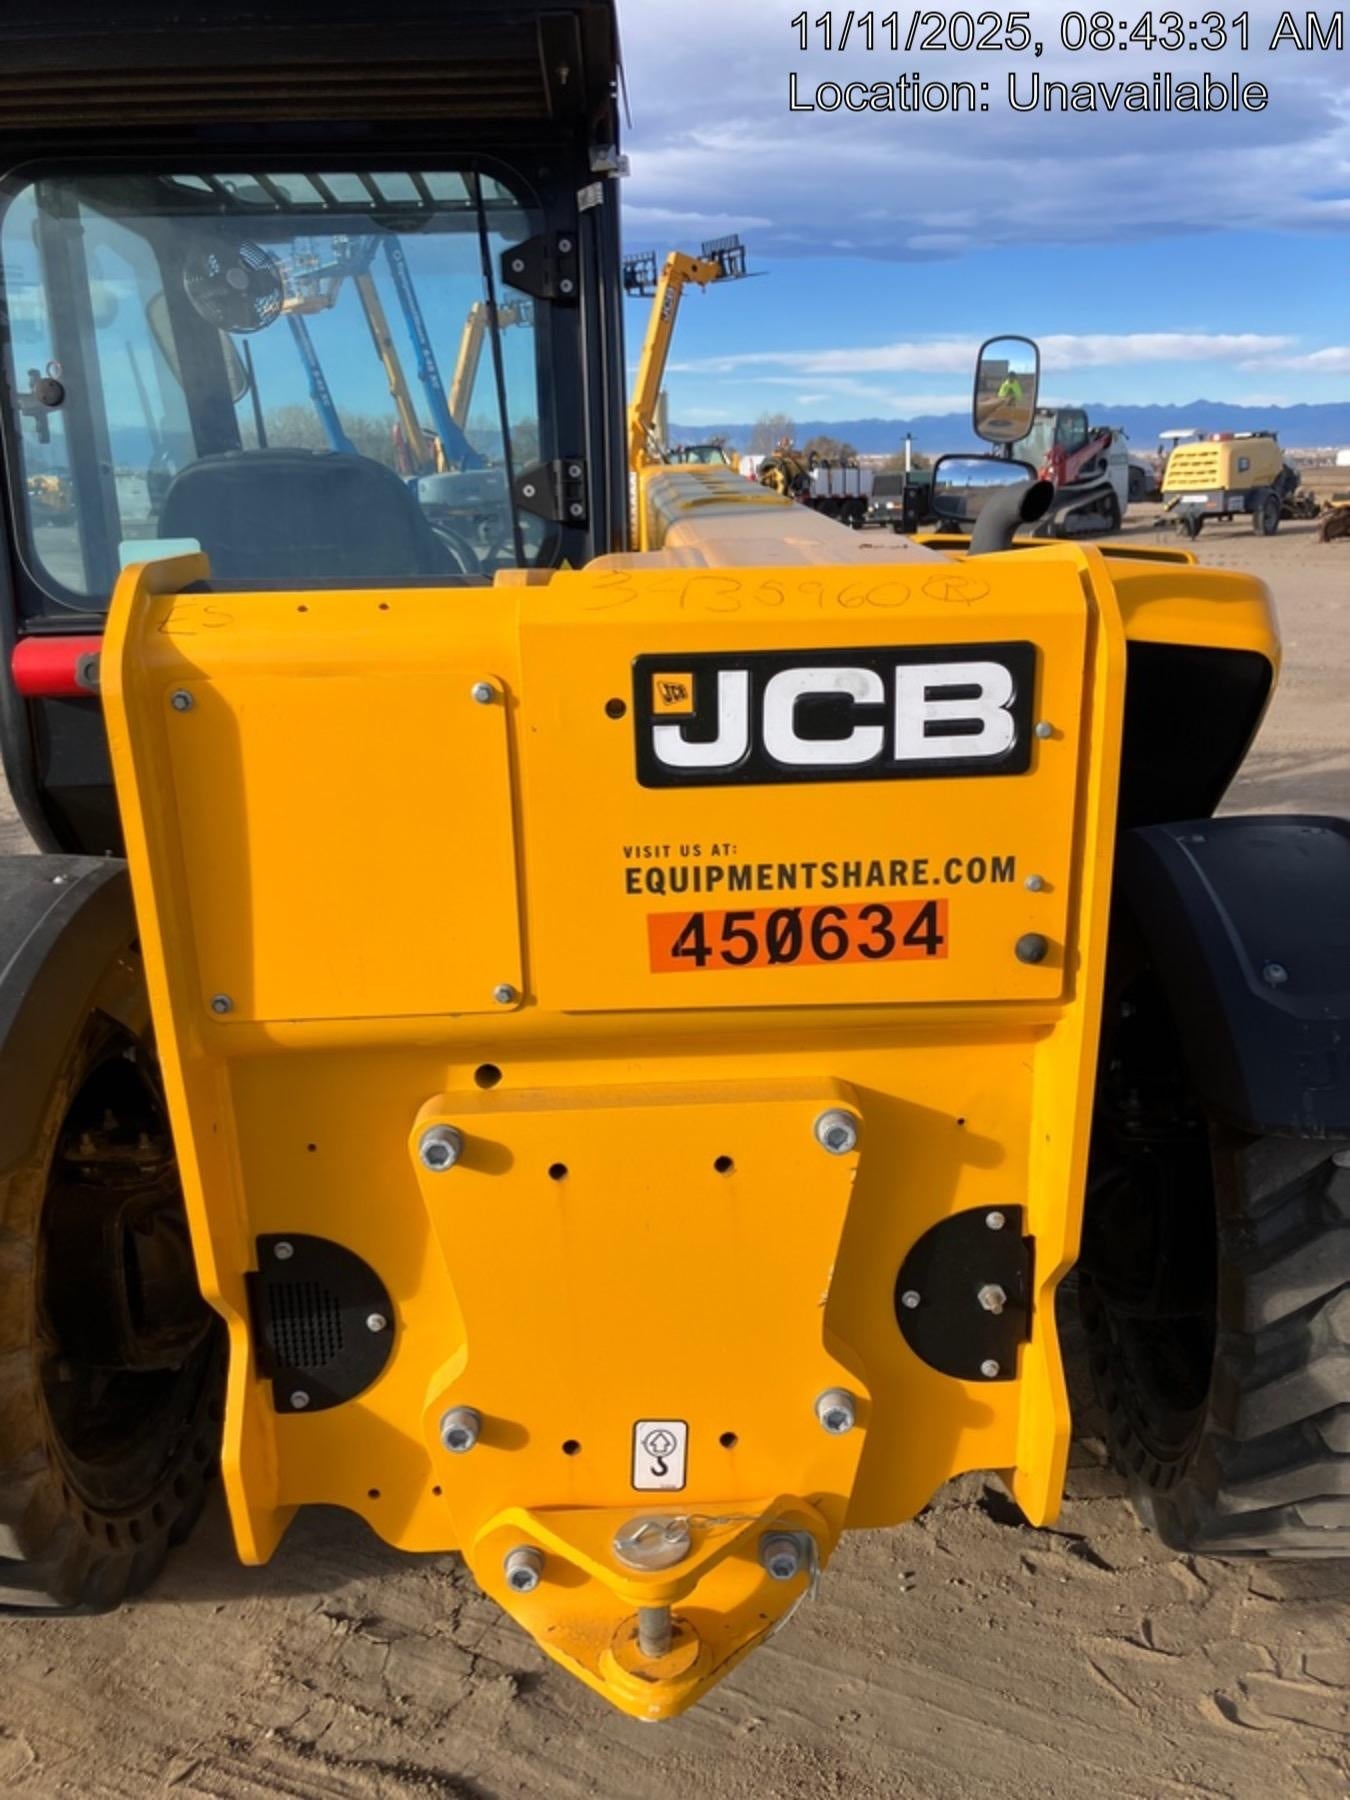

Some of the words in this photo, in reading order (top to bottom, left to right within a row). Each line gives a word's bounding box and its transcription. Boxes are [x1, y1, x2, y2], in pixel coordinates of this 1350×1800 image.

[656, 680, 689, 706] JCB
[652, 661, 1016, 767] JCB
[623, 845, 671, 859] VISIT
[680, 844, 702, 857] US
[711, 843, 738, 857] AT:
[625, 856, 1017, 895] EQUIPMENTSHARE.COM
